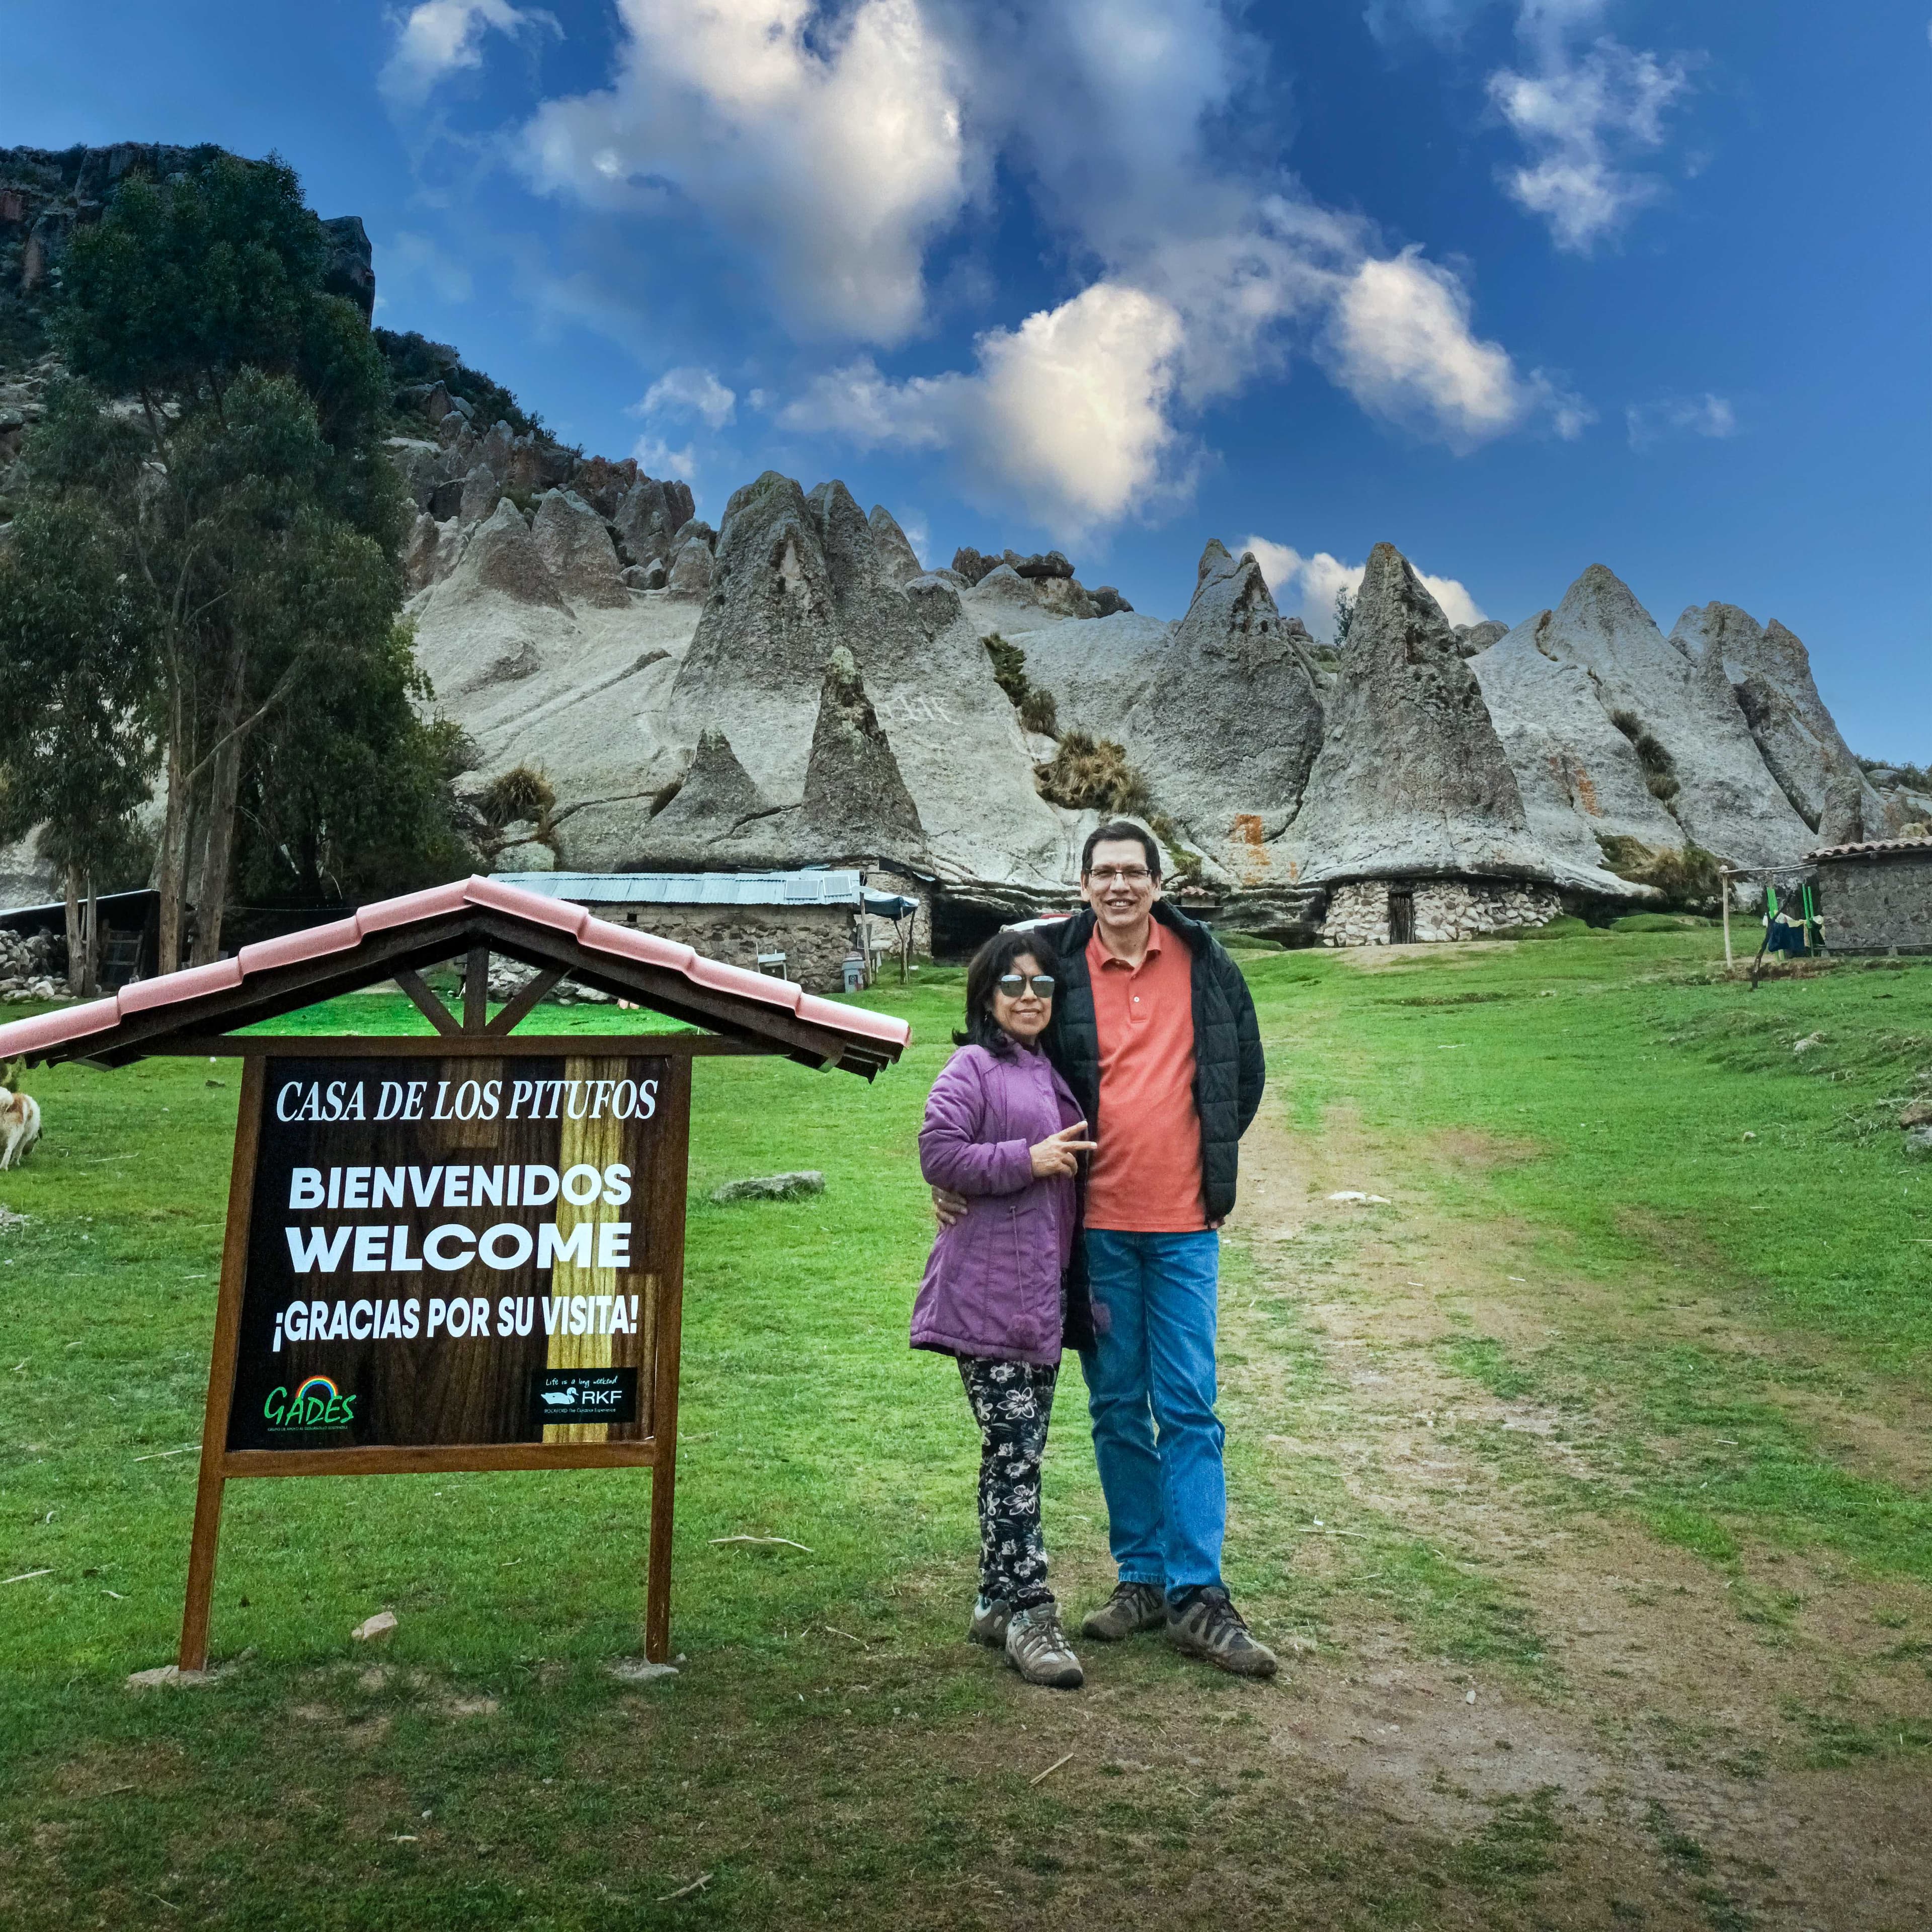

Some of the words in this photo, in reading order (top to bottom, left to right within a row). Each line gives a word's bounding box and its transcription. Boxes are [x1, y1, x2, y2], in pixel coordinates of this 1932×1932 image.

[276, 1081, 370, 1122] CASA
[373, 1081, 428, 1120] DE
[430, 1080, 503, 1120] LOS
[506, 1079, 659, 1120] PITUFOS
[289, 1163, 632, 1210] BIENVENIDOS
[285, 1222, 632, 1273] WELCOME
[272, 1298, 421, 1352] ¡GRACIAS
[427, 1298, 491, 1338] POR
[497, 1296, 535, 1337] SU
[541, 1295, 639, 1336] VISITA!
[546, 1378, 558, 1386] Life
[579, 1378, 590, 1389] long
[593, 1375, 618, 1385] weekend
[582, 1391, 622, 1404] RKF
[264, 1386, 357, 1426] GADES
